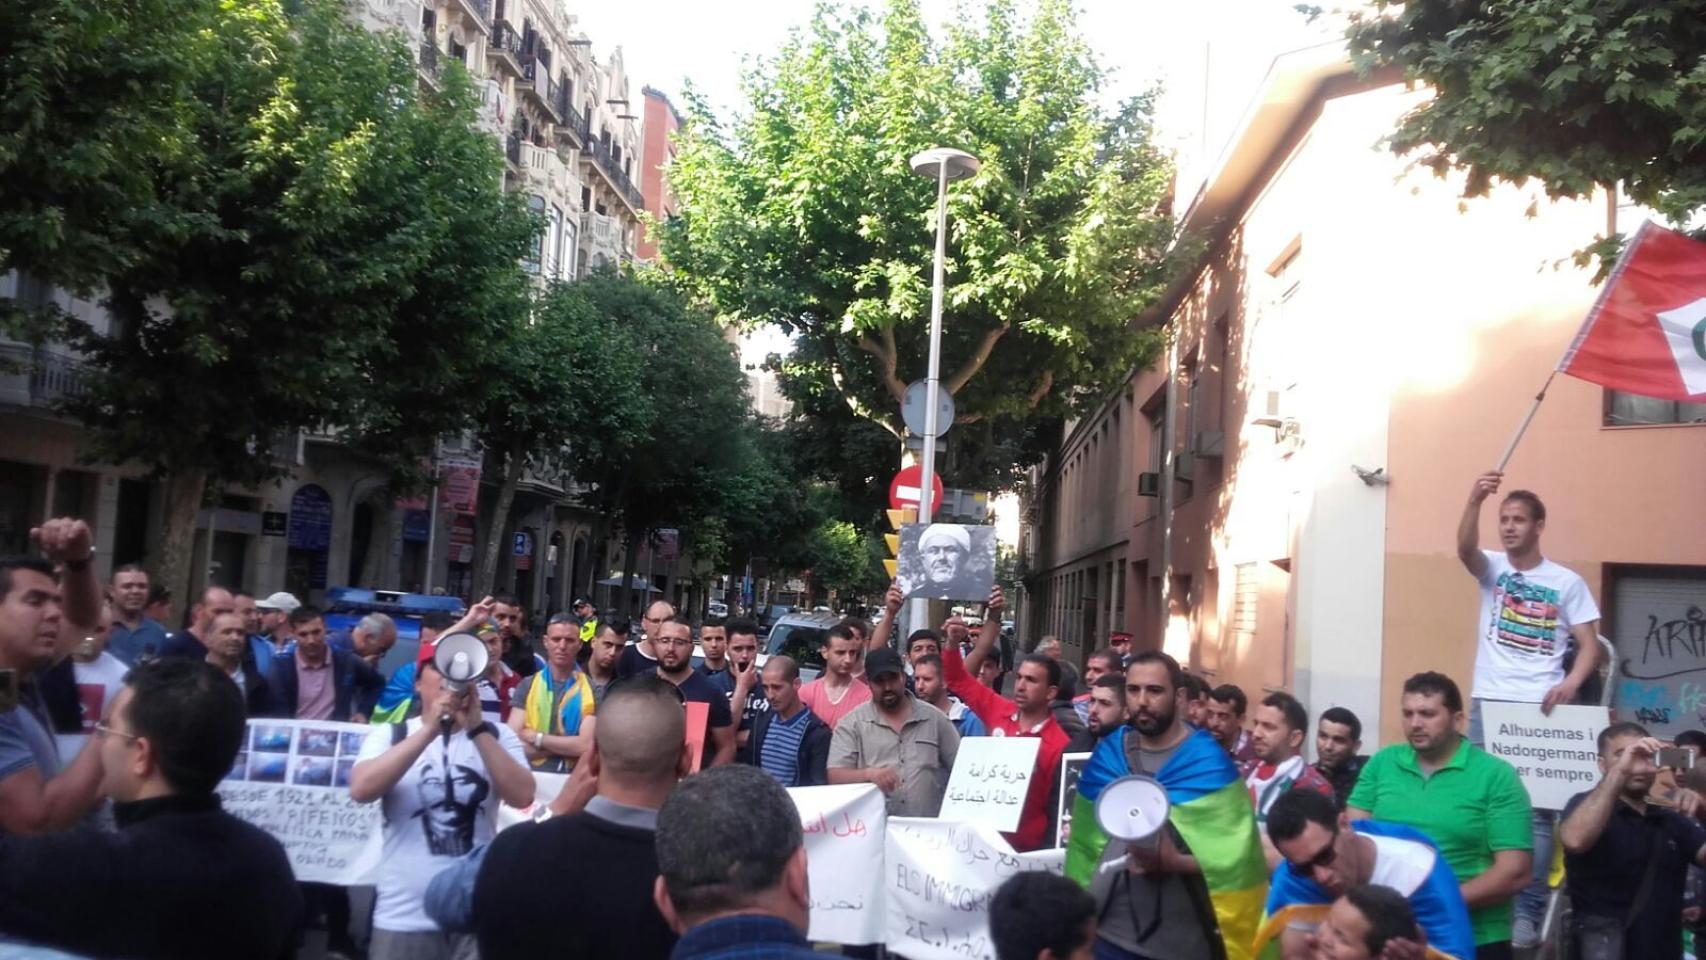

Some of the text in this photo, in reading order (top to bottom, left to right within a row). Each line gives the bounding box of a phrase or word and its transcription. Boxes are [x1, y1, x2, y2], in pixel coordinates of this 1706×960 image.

[1498, 723, 1594, 741] Alhucemas i
[1535, 767, 1594, 783] sempre
